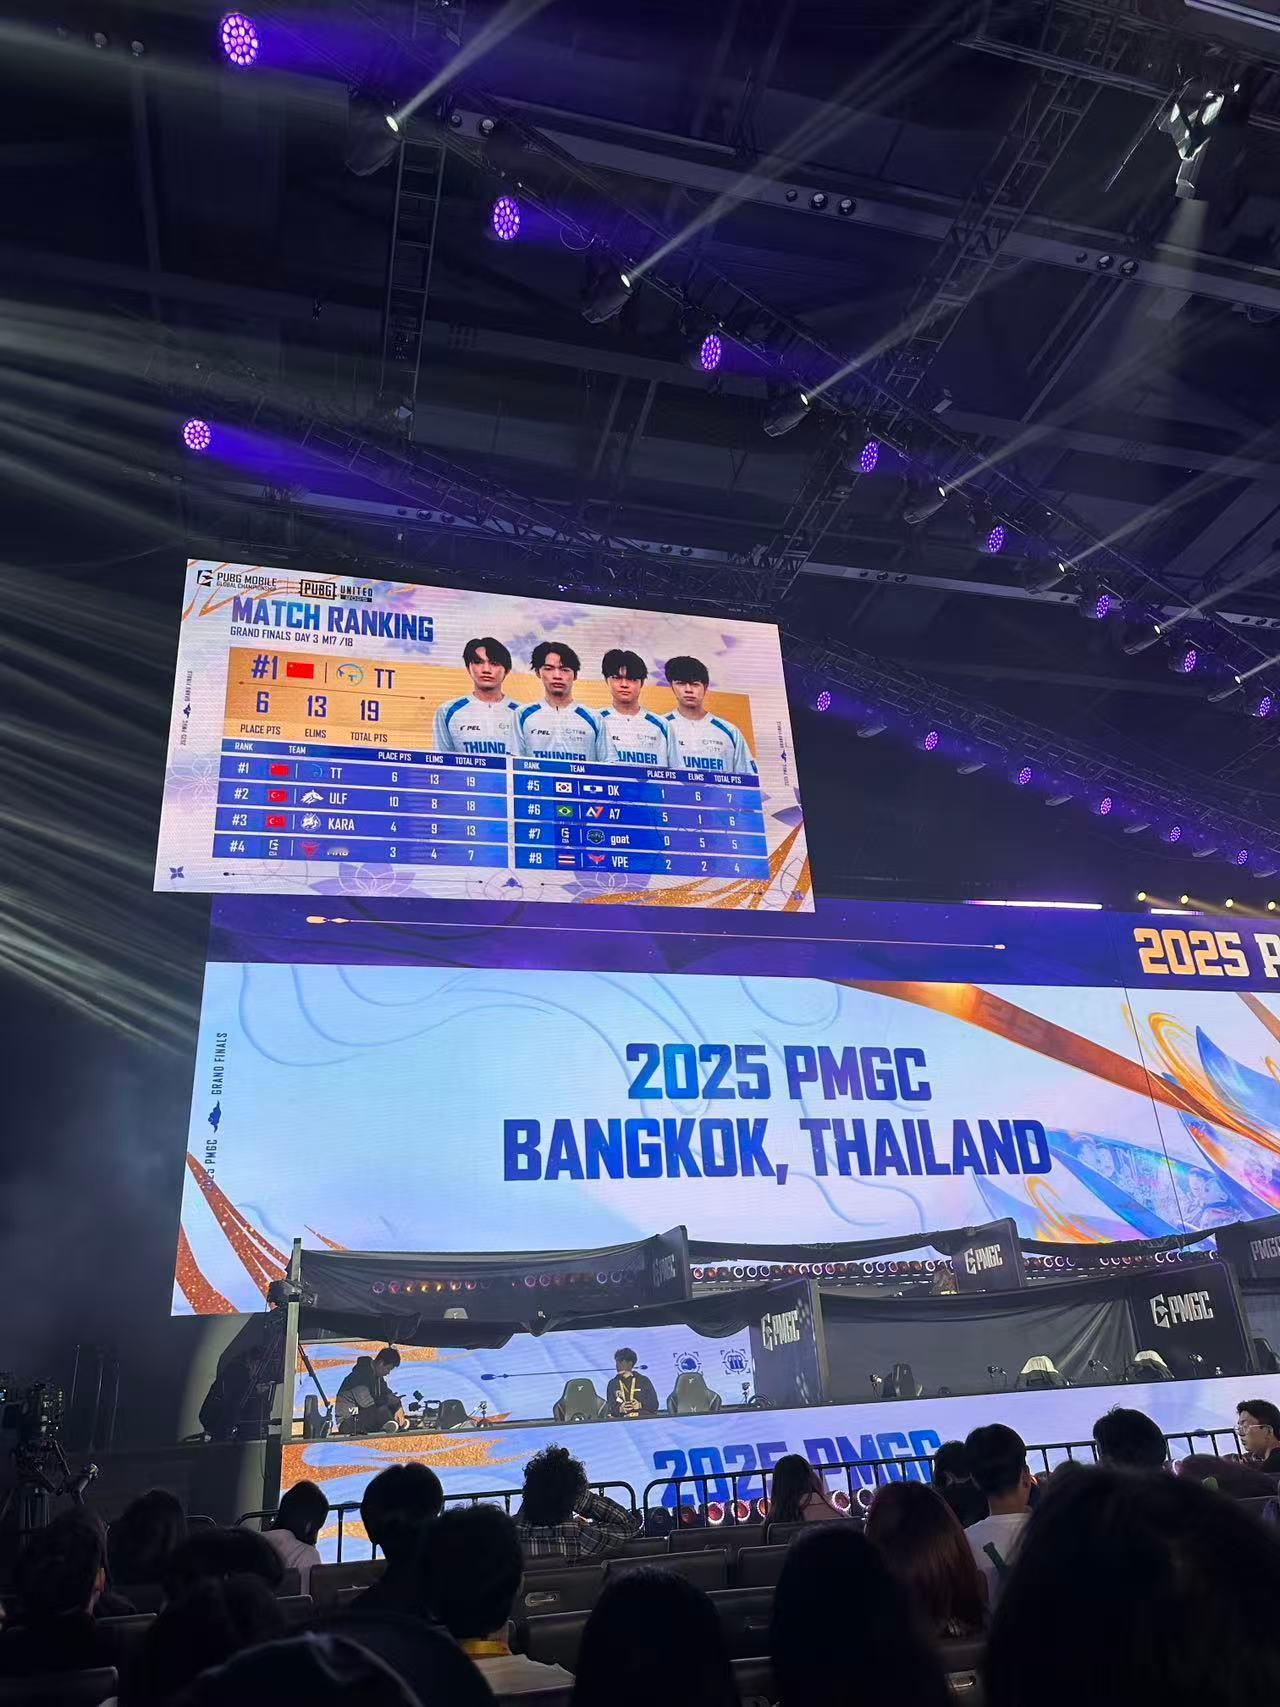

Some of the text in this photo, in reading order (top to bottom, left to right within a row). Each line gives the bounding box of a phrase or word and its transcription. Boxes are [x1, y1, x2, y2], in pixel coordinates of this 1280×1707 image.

[217, 572, 277, 586] PUBG MOBILE
[304, 582, 332, 597] PUBG
[341, 585, 373, 596] UNITED
[232, 596, 434, 642] MATCH RANKING
[230, 626, 260, 638] GRAND
[262, 630, 290, 640] FINALS
[294, 632, 310, 643] DAY
[312, 634, 319, 644] 3
[322, 635, 336, 644] M17
[252, 654, 278, 680] #1
[374, 668, 396, 689] TT
[256, 691, 270, 714] 6
[307, 695, 328, 718] 13
[360, 699, 379, 722] 19
[240, 724, 281, 735] PLACE PTS
[304, 728, 326, 738] ELIMS
[351, 731, 388, 743] TOTAL PTS
[234, 742, 486, 766] RANK TEAM PLACE PTS ELIMS TOTAL PTS
[238, 762, 476, 786] #1 TT 6 13 19
[524, 762, 540, 770] RANK
[570, 764, 586, 772] TEAM
[647, 770, 664, 778] PLACE
[714, 774, 730, 782] TOTAL
[730, 776, 742, 784] PTS
[234, 788, 476, 811] #2 ULF 10 8 18
[527, 780, 540, 791] #5
[608, 785, 620, 796] DK
[695, 792, 701, 801] 6
[727, 794, 732, 803] 7
[232, 814, 476, 836] #3 KARA 4 9 13
[528, 804, 736, 826] #6 A7 5 1 6
[230, 840, 474, 861] #4 3 4 7
[528, 828, 738, 850] #7 goat 0 5 5
[528, 852, 740, 872] #8 VPE 2 2 4
[1133, 928, 1250, 977] 2025
[214, 1032, 228, 1062] FINALS
[211, 1066, 224, 1095] GRAND
[626, 1043, 933, 1101] 2025 PMGC
[205, 1139, 218, 1164] PMGC
[503, 1118, 1053, 1186] BANGKOK, THAILAND
[974, 1244, 1003, 1270] PMGC
[1168, 1290, 1214, 1324] PMGC
[772, 1309, 800, 1346] PMGC
